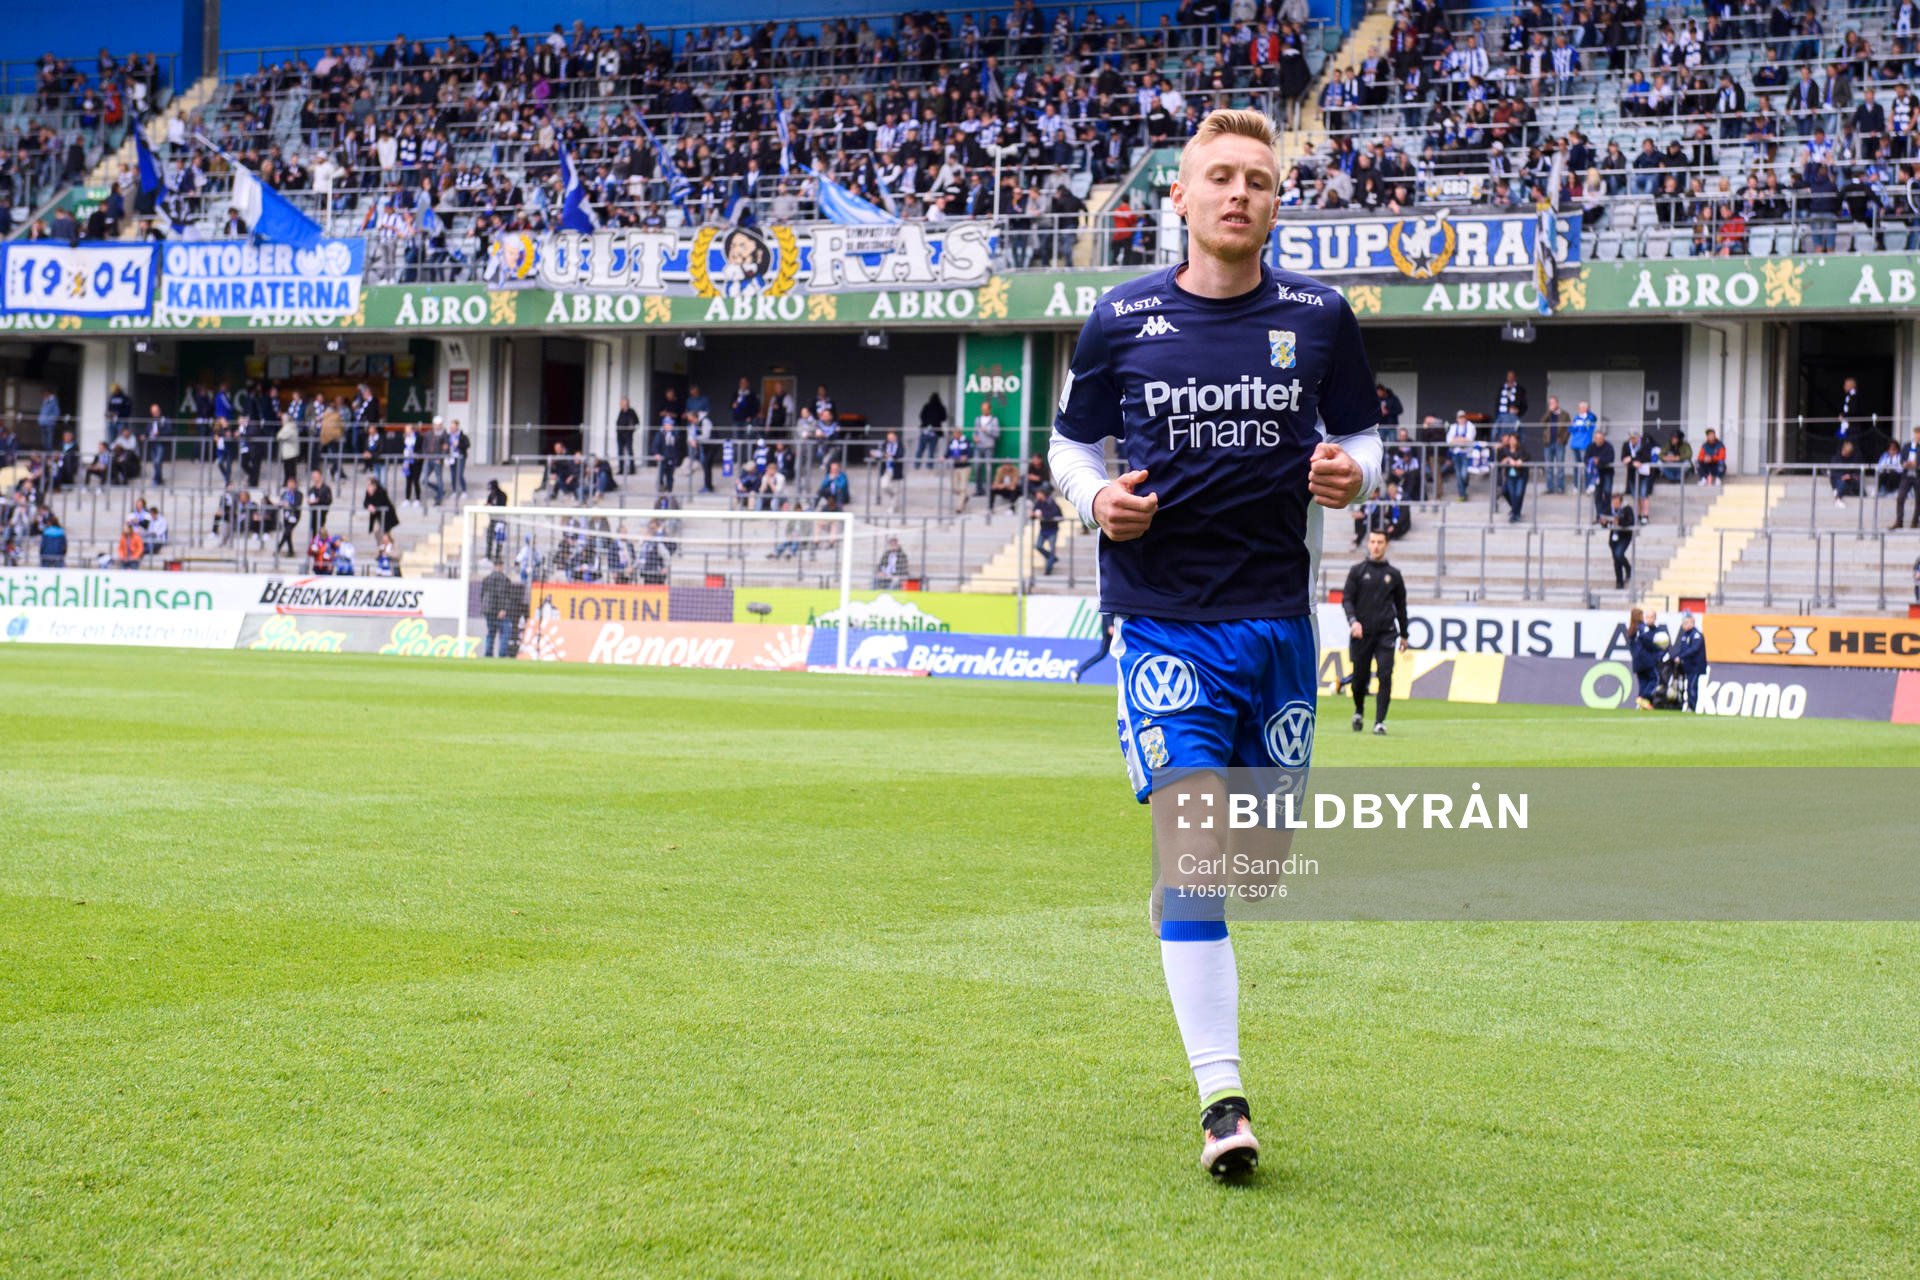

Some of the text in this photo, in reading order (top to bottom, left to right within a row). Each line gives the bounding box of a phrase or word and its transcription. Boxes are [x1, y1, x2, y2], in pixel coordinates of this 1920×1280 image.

[167, 245, 294, 277] OKTOBER
[1279, 223, 1389, 270] SUP
[167, 280, 351, 310] KAMRATERNA
[1044, 282, 1115, 317] ÅB
[1277, 285, 1324, 306] RASTA
[1628, 270, 1759, 306] ÅBRO
[395, 292, 488, 325] ÅBRO
[545, 291, 641, 323] ÅBRO
[1111, 296, 1162, 317] RASTA
[1144, 375, 1303, 417] Prioritet
[1168, 415, 1280, 450] Finans
[588, 622, 735, 667] Renova
[1404, 616, 1553, 658] ORRIS
[1829, 631, 1920, 655] HEC
[907, 645, 1079, 680] Björnkläder
[1696, 665, 1807, 719] komo
